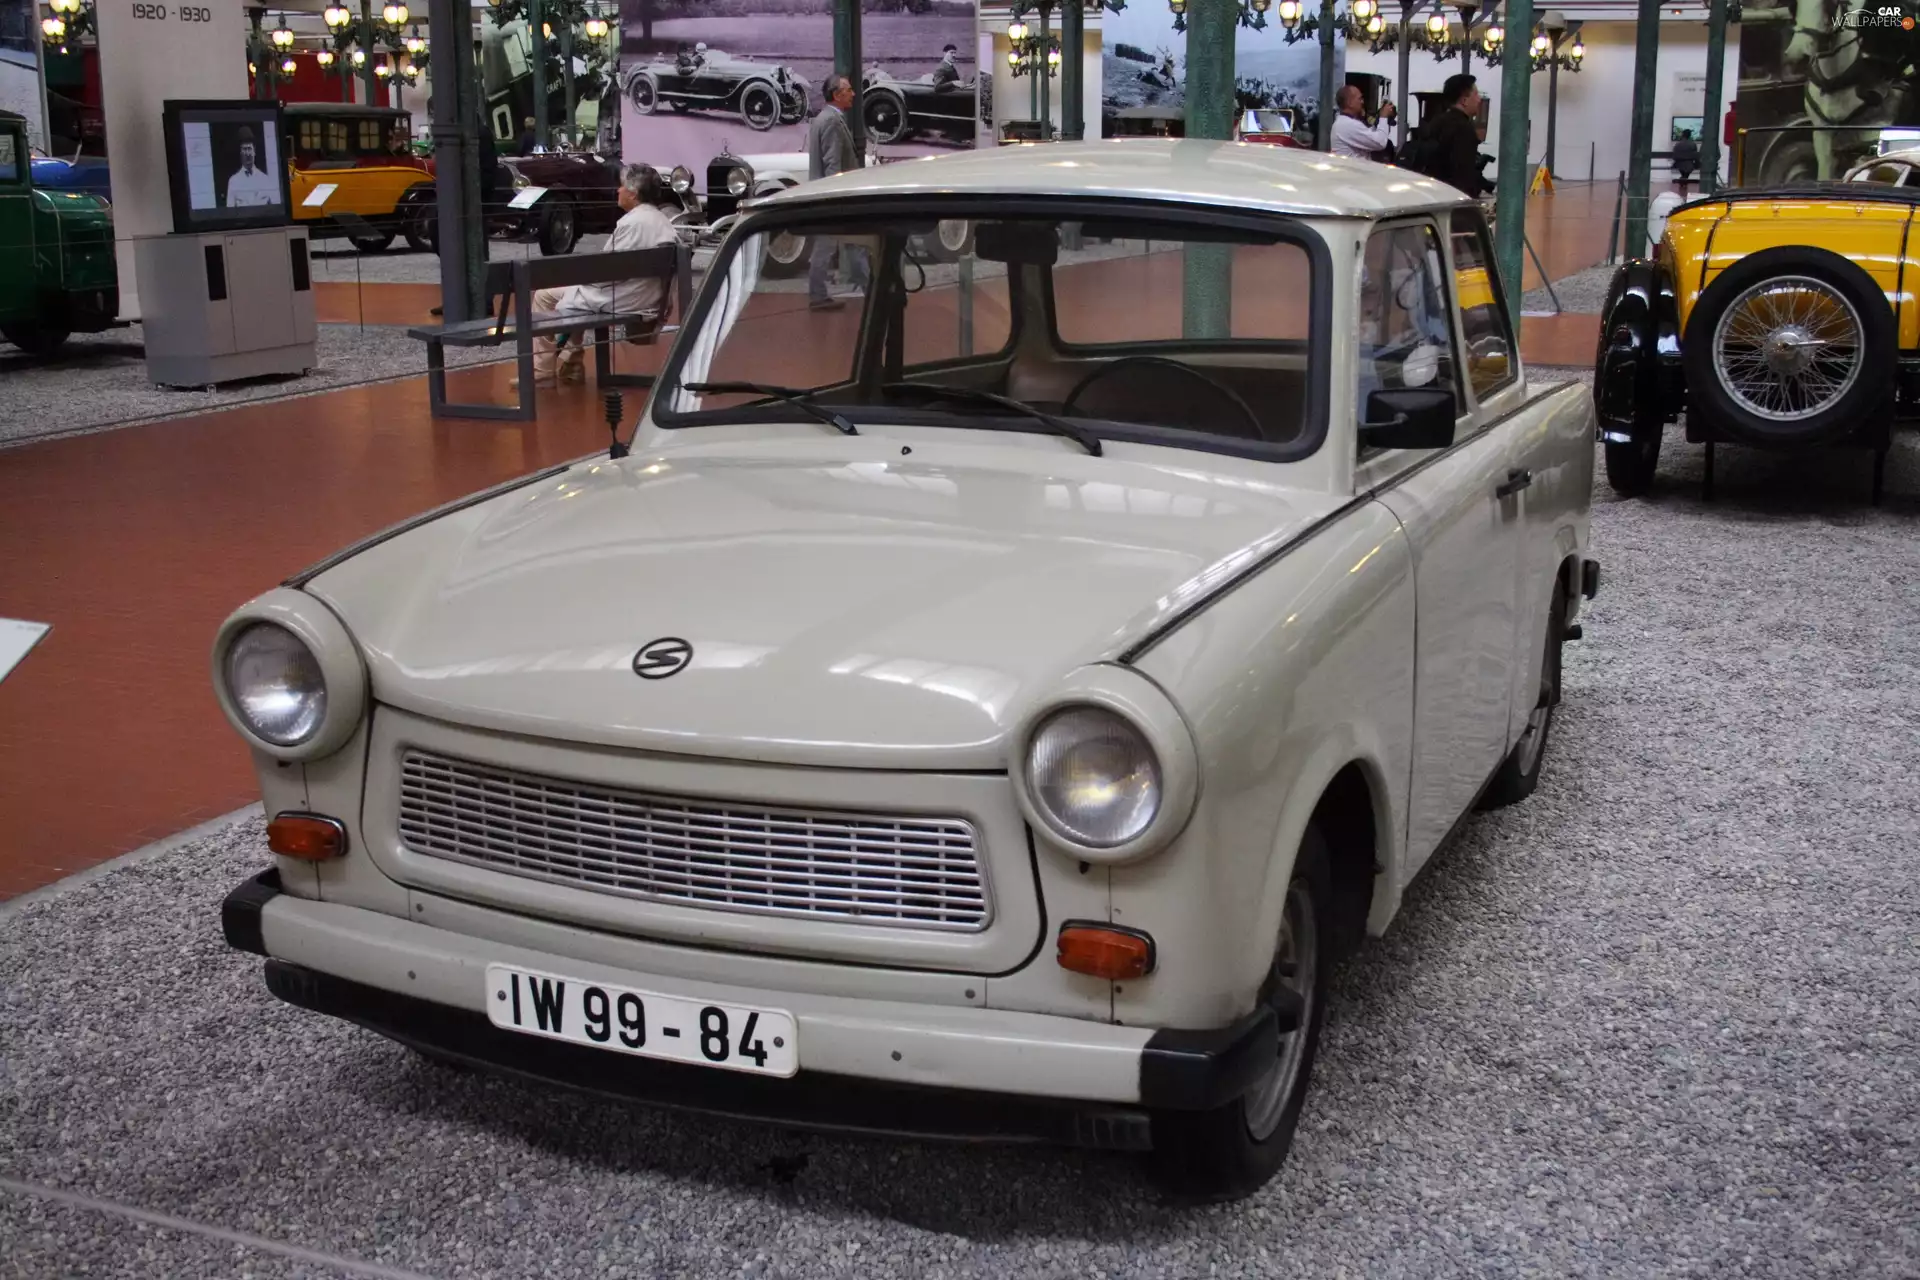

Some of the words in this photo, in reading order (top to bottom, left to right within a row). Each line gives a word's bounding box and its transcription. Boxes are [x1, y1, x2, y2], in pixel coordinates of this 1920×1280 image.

[132, 3, 166, 20] 1920
[180, 6, 211, 22] 1930
[511, 973, 565, 1033] IW
